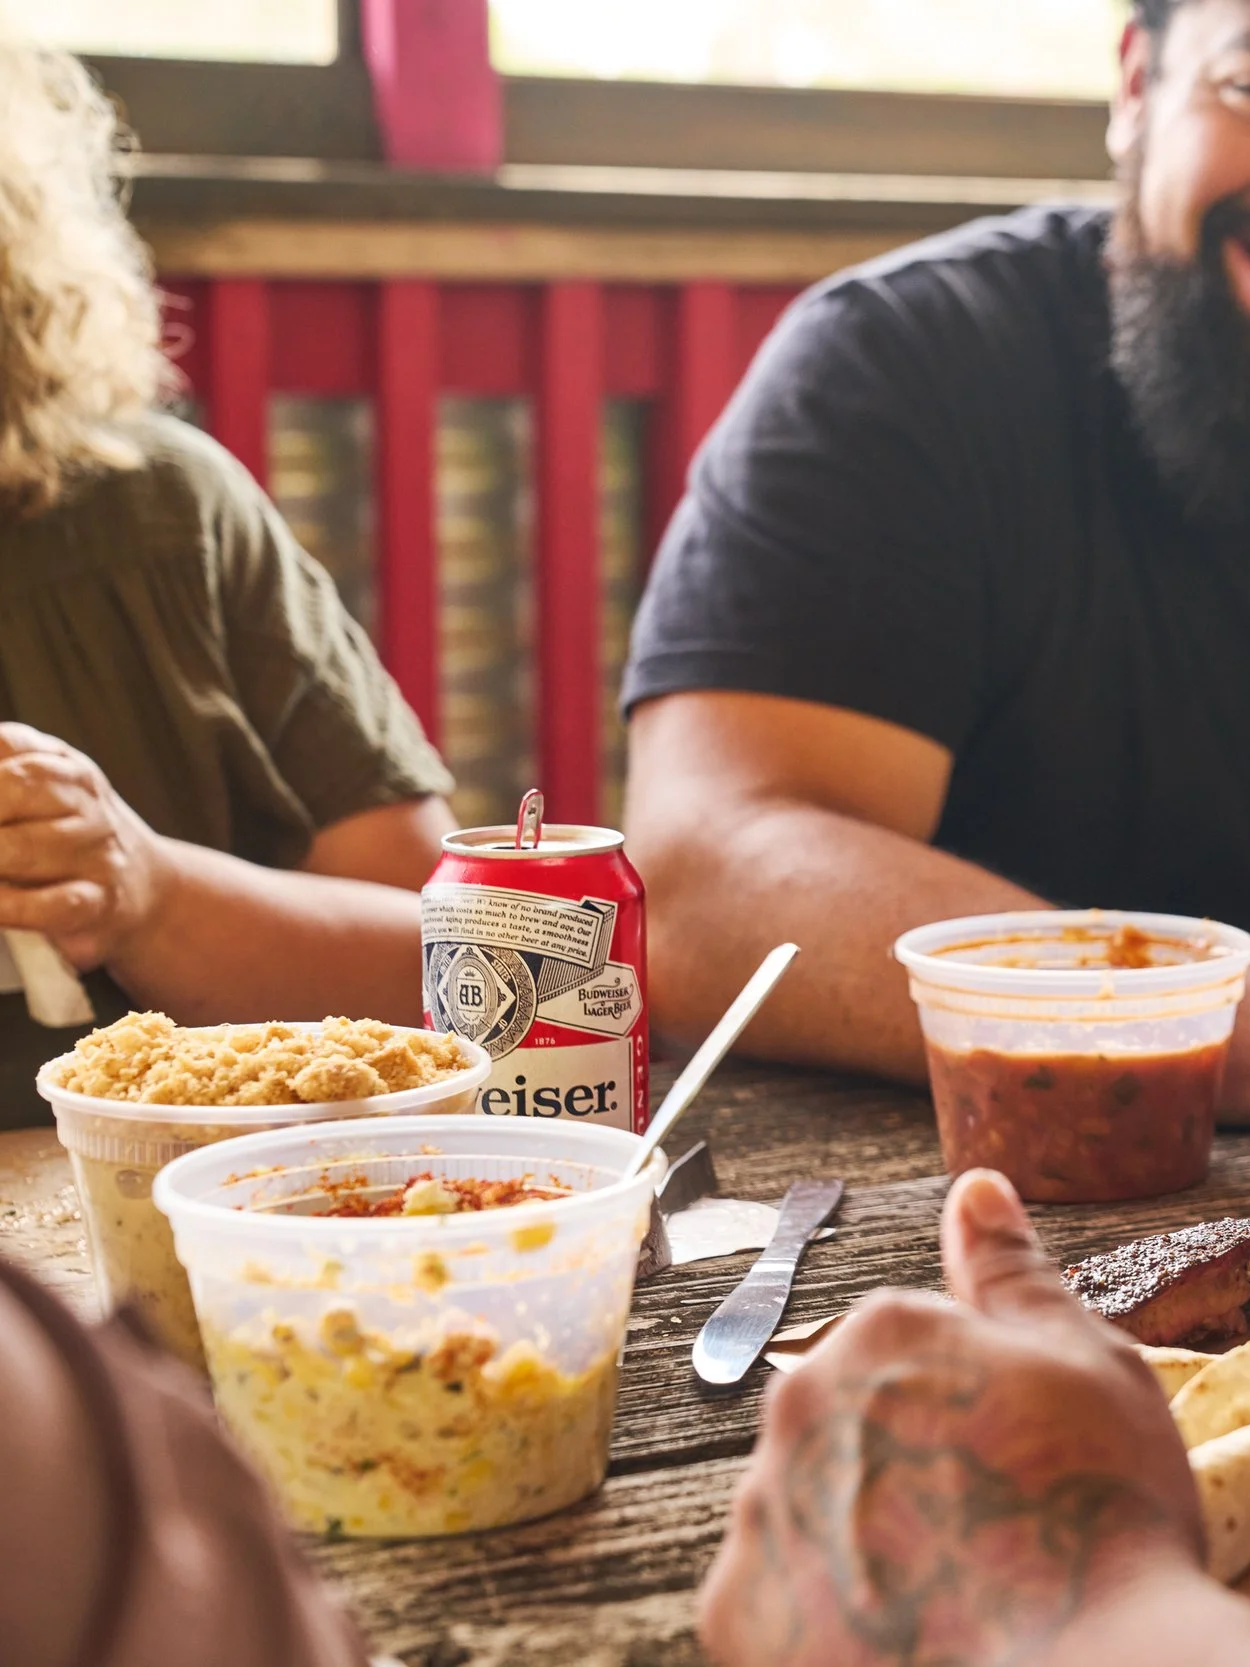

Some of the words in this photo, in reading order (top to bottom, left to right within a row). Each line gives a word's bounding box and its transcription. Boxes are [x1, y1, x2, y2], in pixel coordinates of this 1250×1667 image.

[488, 898, 508, 908] know
[510, 902, 520, 911] of
[520, 904, 532, 912] no
[533, 905, 558, 917] brand
[559, 912, 594, 927] produced
[464, 917, 500, 927] produces
[509, 922, 532, 934] taste,
[541, 930, 589, 947] smoothness
[485, 910, 507, 918] much
[509, 911, 518, 920] to
[519, 913, 541, 924] brew
[541, 919, 559, 928] and
[577, 926, 592, 937] Our
[497, 931, 519, 940] other
[520, 934, 540, 945] beer
[540, 939, 550, 947] at
[550, 942, 567, 952] any
[578, 988, 630, 1001] BUDWEISER
[584, 1002, 614, 1017] LAGER
[534, 1037, 556, 1046] 1876
